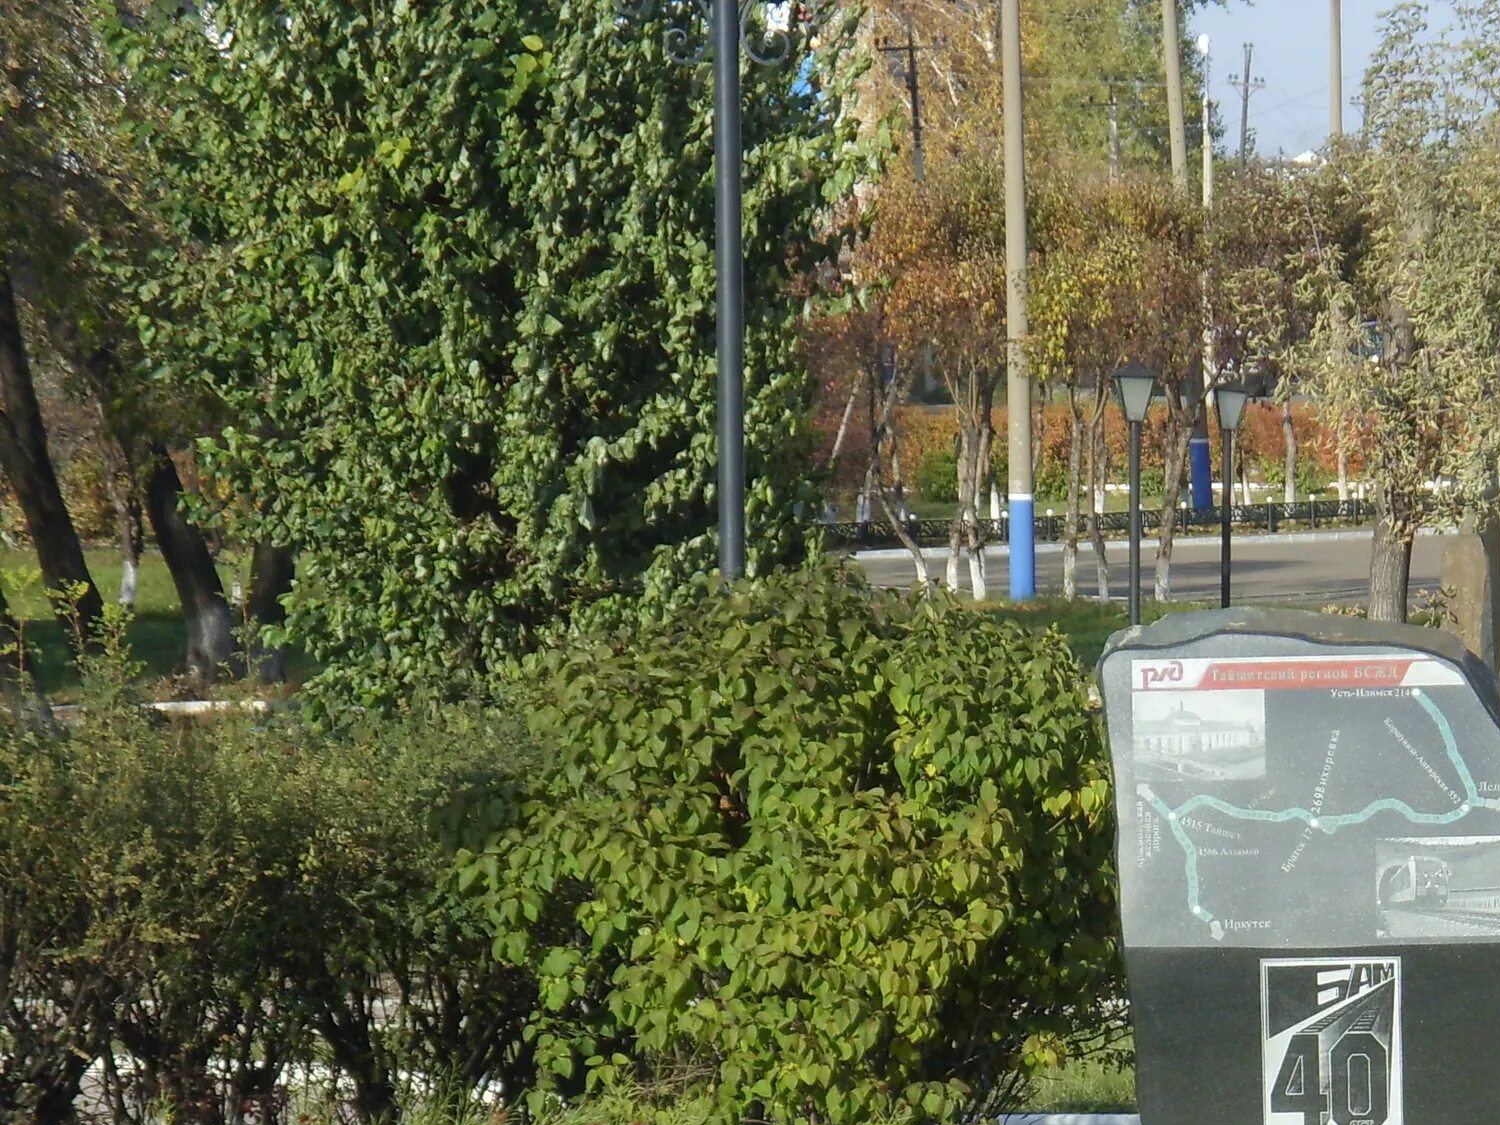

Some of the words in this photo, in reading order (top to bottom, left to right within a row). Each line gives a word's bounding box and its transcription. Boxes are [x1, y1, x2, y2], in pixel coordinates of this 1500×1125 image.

[1299, 667, 1349, 683] регион
[1354, 665, 1399, 679] ВСЖД
[1330, 688, 1393, 698] Усть-Илимск
[1224, 918, 1272, 932] Иркутск
[1316, 962, 1395, 1006] БАМ
